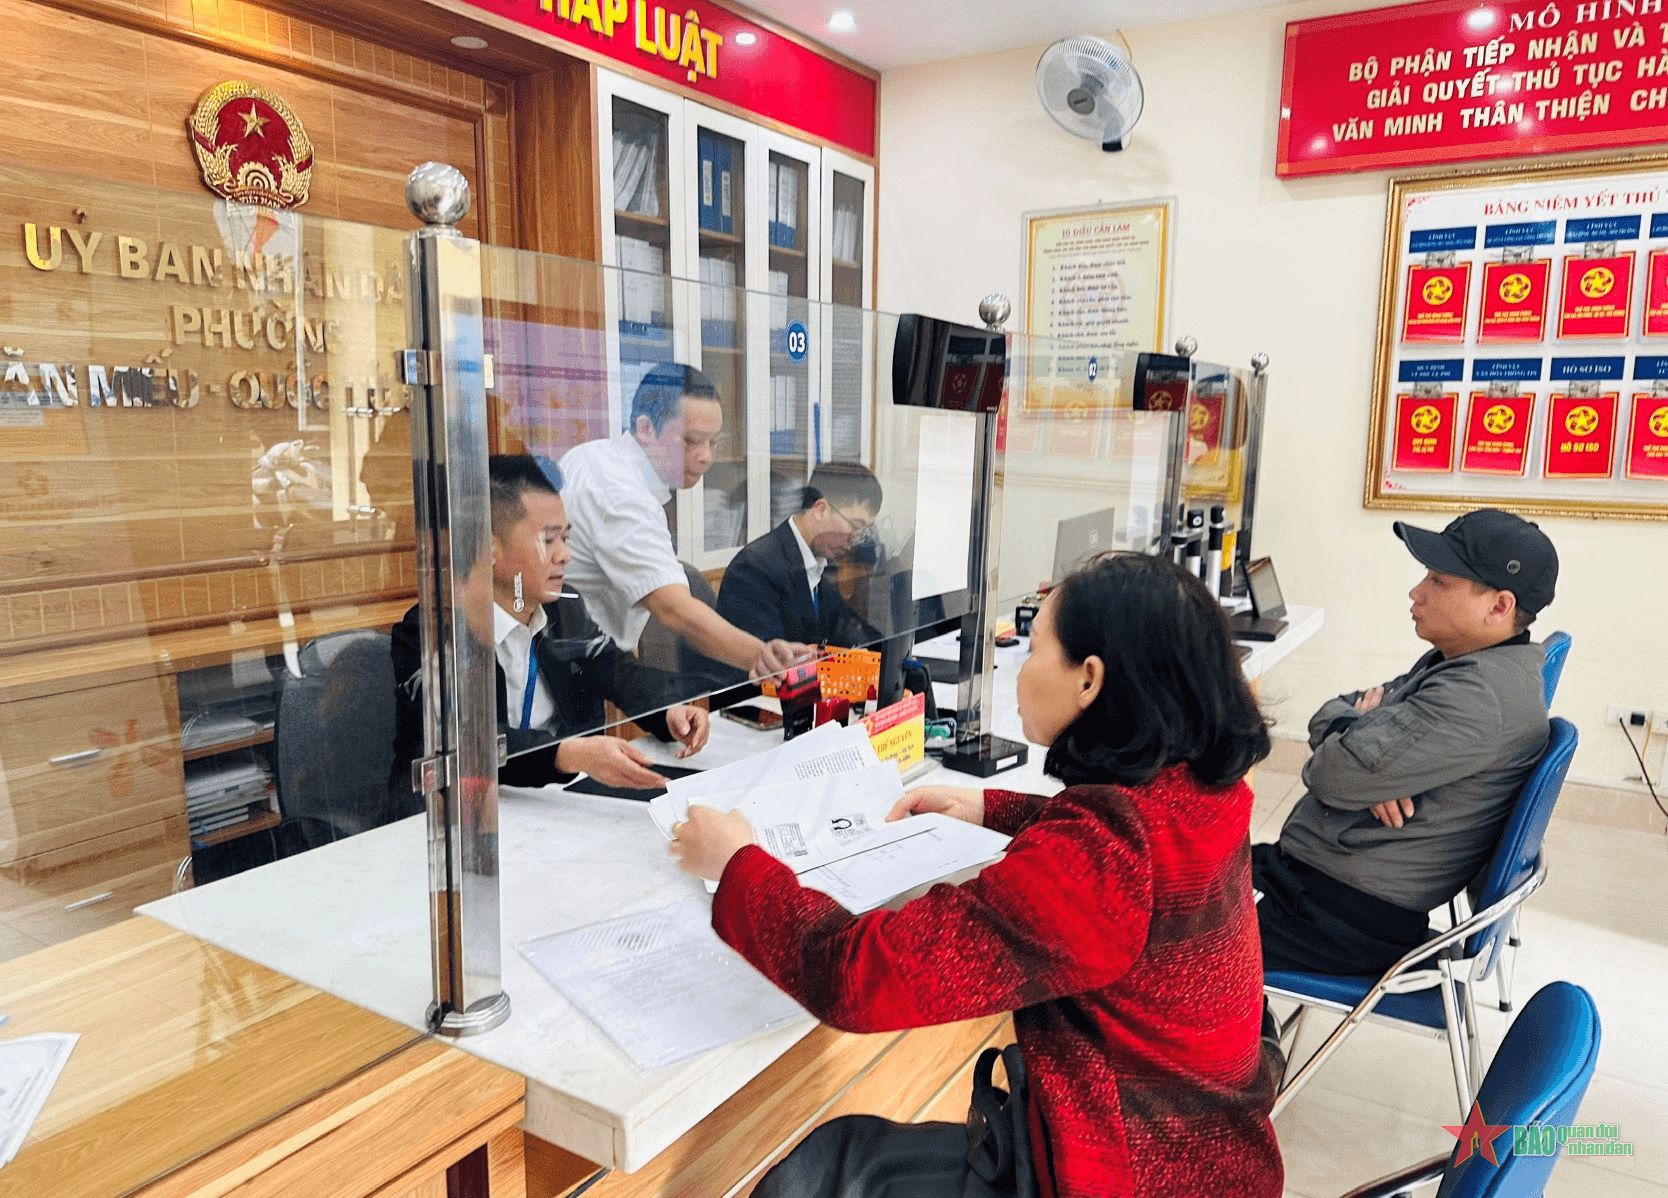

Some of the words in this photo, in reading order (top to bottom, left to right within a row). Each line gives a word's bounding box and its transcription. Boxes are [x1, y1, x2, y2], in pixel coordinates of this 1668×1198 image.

[635, 0, 723, 82] LUẬT
[1509, 2, 1561, 33] MÔ
[1348, 55, 1379, 86] BỘ
[1389, 47, 1452, 77] PHẬN
[1463, 35, 1516, 68] TIẾP
[1527, 30, 1598, 61] NHẬN
[1612, 21, 1646, 49] VÀ
[1366, 80, 1411, 110] GIẢI
[1422, 67, 1501, 105] QUYẾT
[1511, 60, 1561, 93] THỦ
[1572, 59, 1624, 89] TỤC
[1332, 116, 1374, 143] VĂN
[1383, 111, 1443, 137] MINH
[1460, 99, 1525, 129] THÂN
[1536, 89, 1611, 121] THIỆN
[1484, 197, 1529, 217] BẢNG
[1534, 193, 1579, 211] NIÊM
[1583, 187, 1618, 208] YẾT
[116, 235, 222, 289] BAN
[233, 250, 350, 299] NHÂN
[789, 331, 806, 353] 03
[1088, 361, 1098, 377] 02
